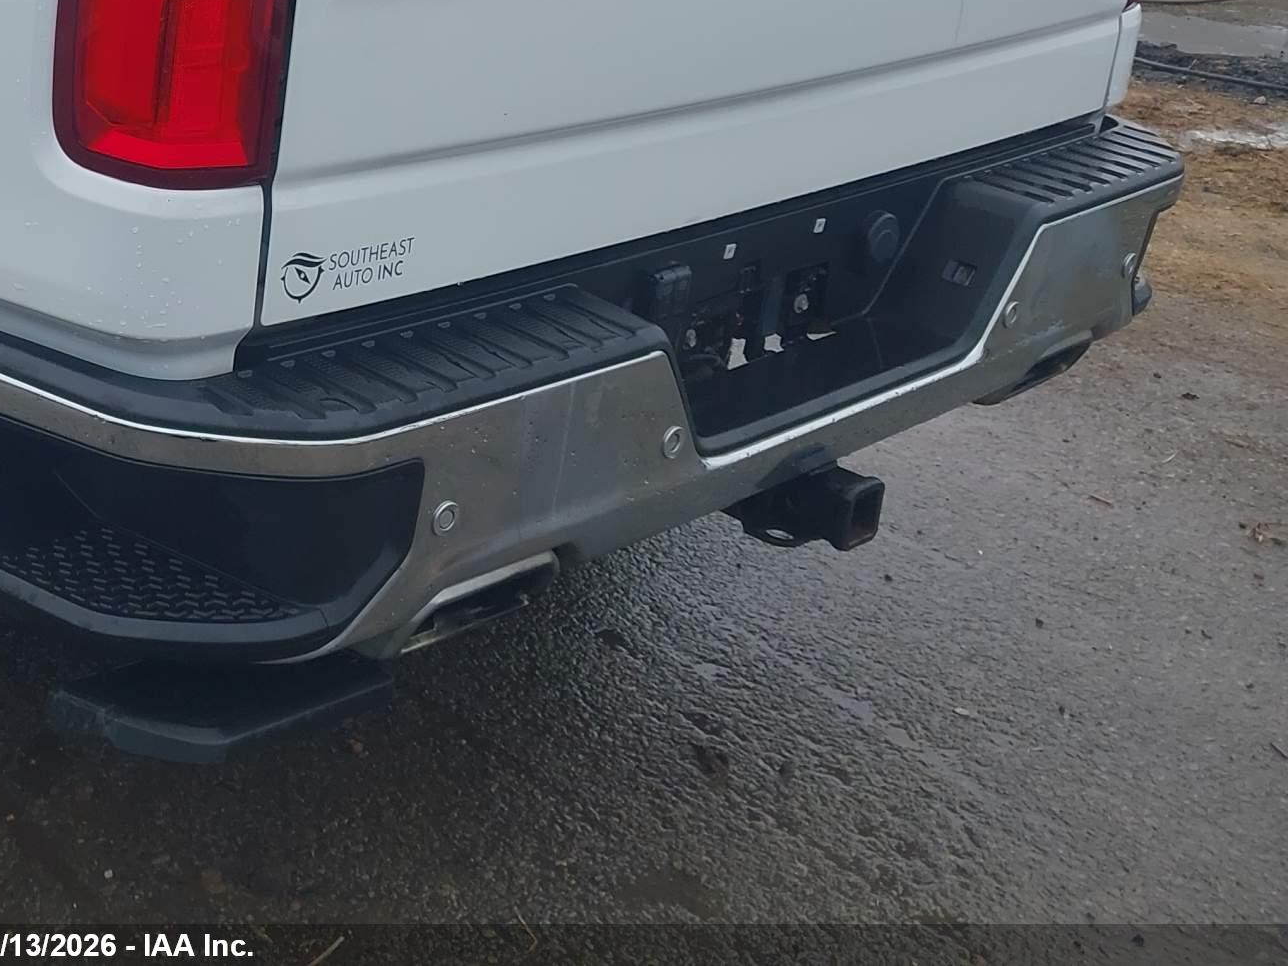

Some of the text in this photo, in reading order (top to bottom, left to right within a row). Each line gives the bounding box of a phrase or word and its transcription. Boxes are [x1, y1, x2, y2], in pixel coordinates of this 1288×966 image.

[328, 237, 416, 271] SOUTHEAST
[332, 260, 404, 290] AUTO INC
